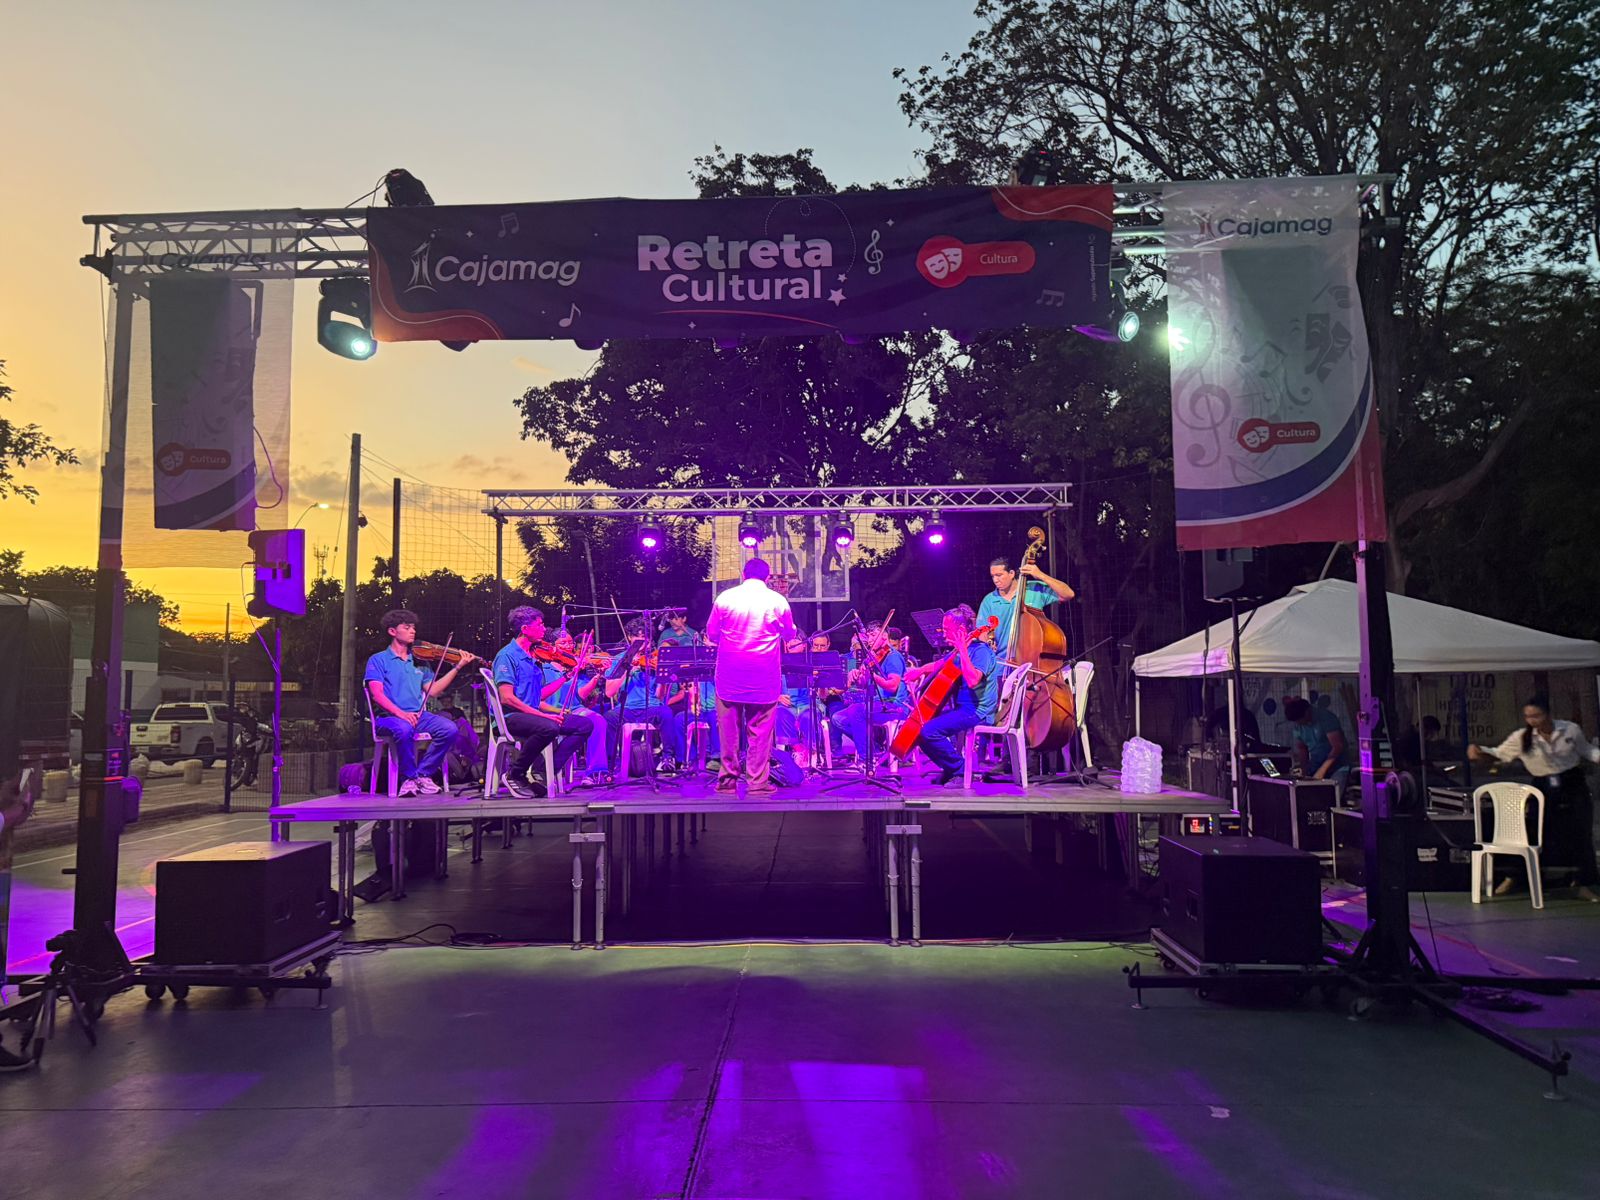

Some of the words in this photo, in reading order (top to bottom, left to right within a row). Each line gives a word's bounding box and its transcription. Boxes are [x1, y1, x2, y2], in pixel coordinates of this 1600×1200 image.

[1217, 217, 1333, 238] Cajamag
[638, 234, 833, 271] Retreta
[980, 253, 1018, 264] Cultura
[435, 254, 582, 287] Cajamag
[662, 269, 822, 302] Cultural
[1276, 428, 1316, 438] Cultura
[189, 454, 227, 464] Cultura
